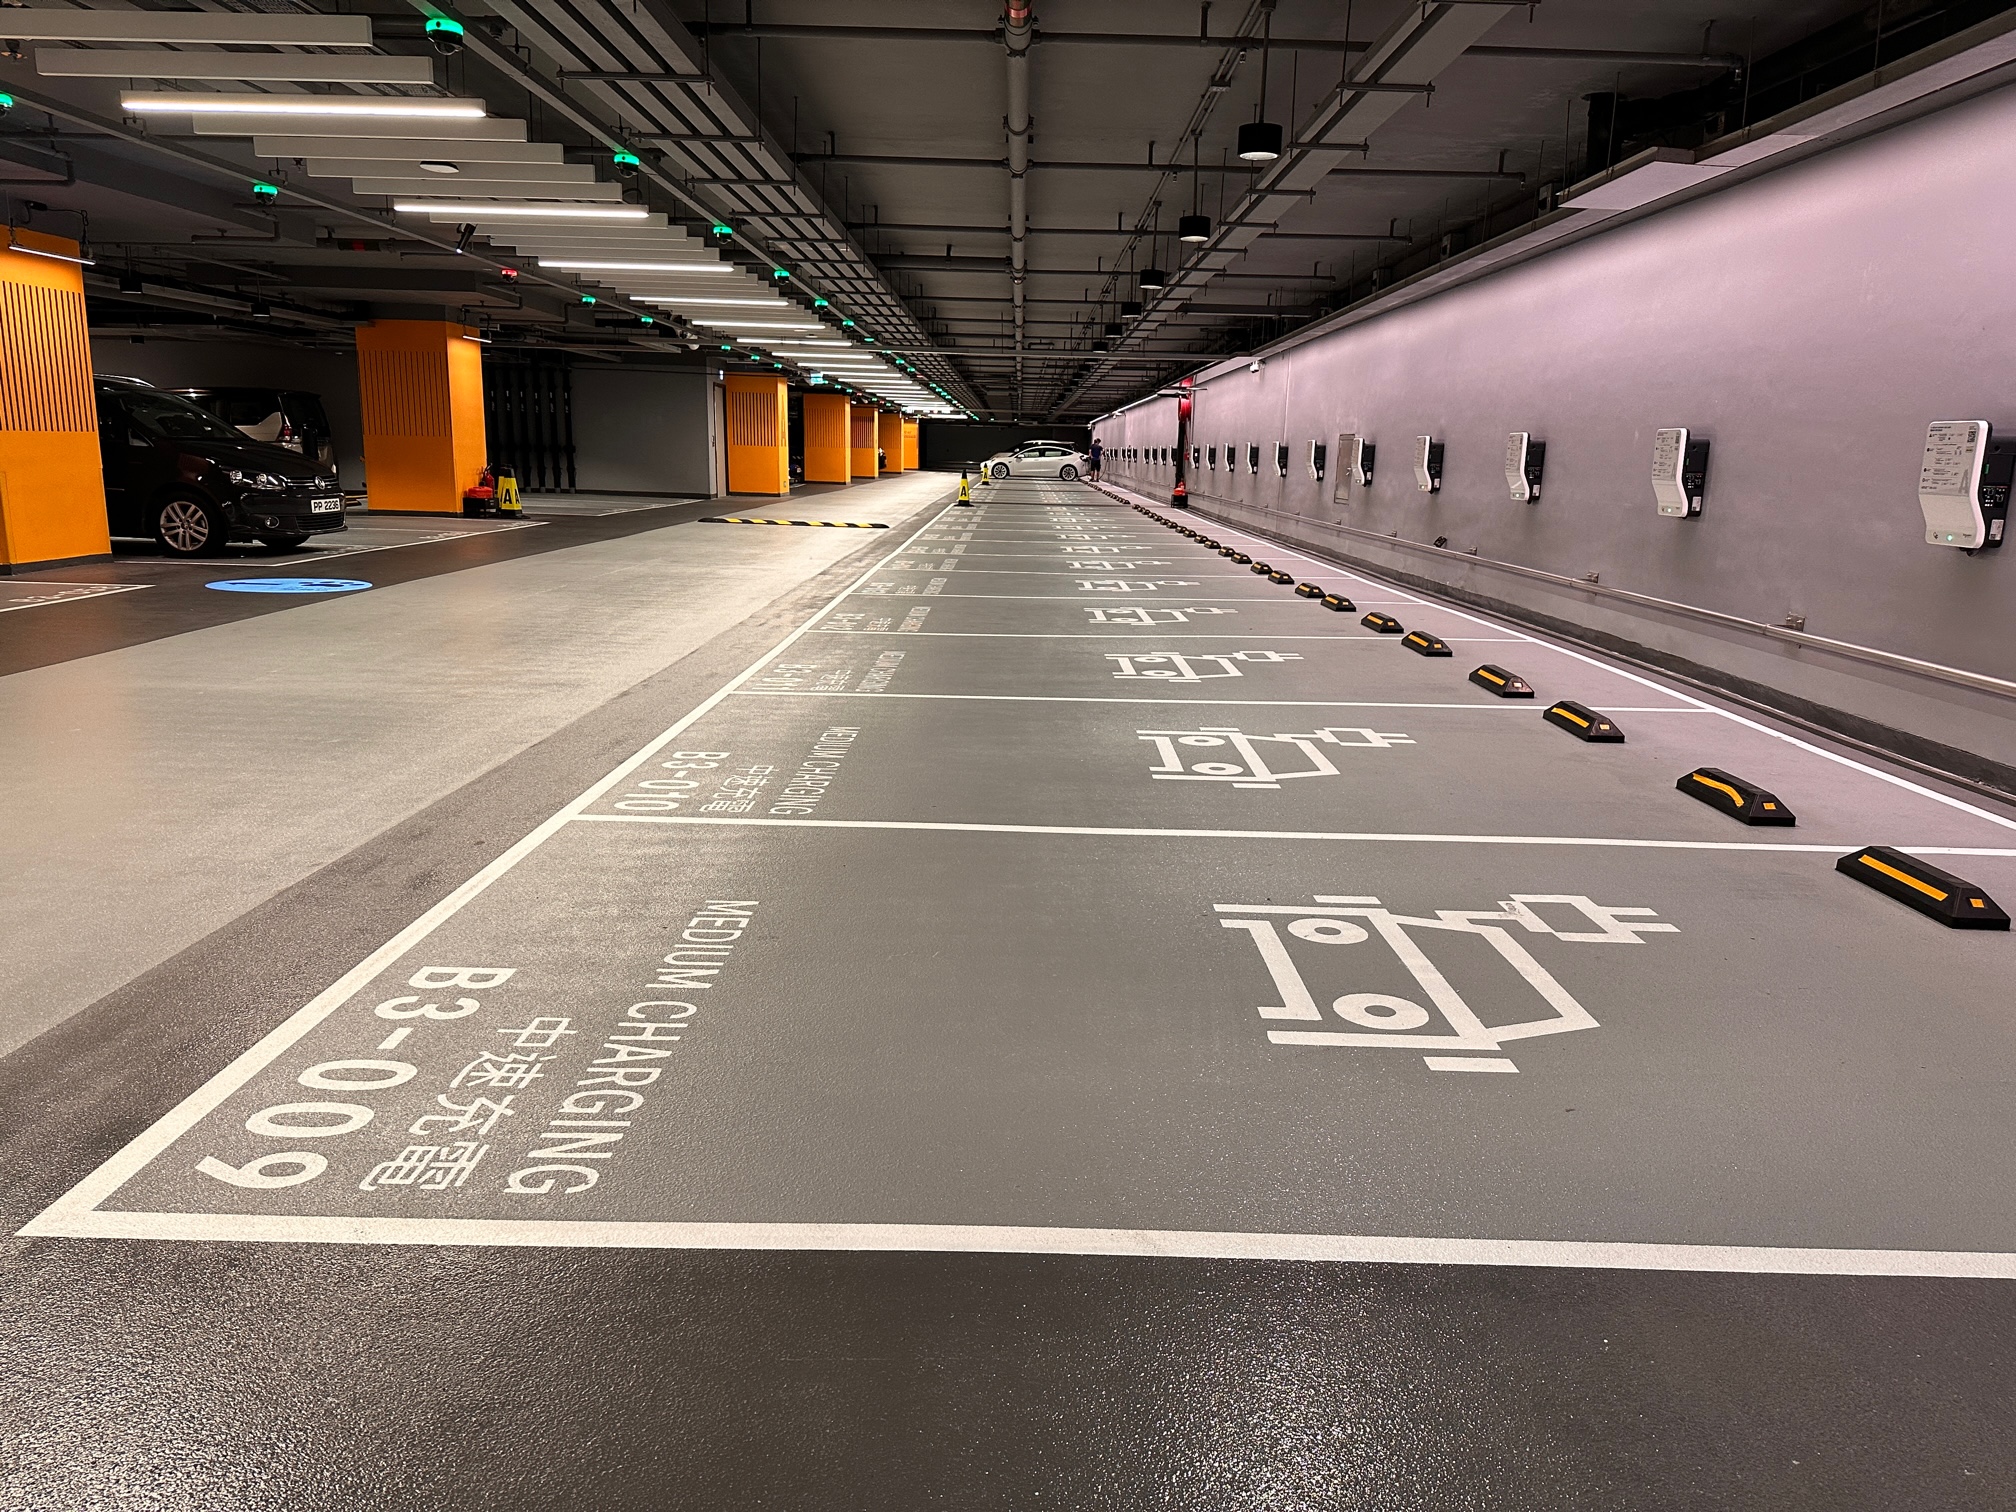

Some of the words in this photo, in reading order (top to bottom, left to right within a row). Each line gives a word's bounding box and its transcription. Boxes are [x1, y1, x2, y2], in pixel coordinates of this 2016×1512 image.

[313, 501, 323, 511] PP
[503, 488, 512, 505] A
[960, 485, 967, 497] A
[752, 664, 818, 691] B3-011
[807, 726, 861, 759] MEDIUM
[614, 751, 731, 811] B3-010
[699, 764, 780, 813] 中速充電
[768, 760, 841, 815] CHARGING
[656, 899, 760, 989] MEDIUM
[195, 964, 518, 1190] B3-009
[504, 1000, 698, 1194] CHARGING
[359, 1016, 578, 1192] 中速充電
